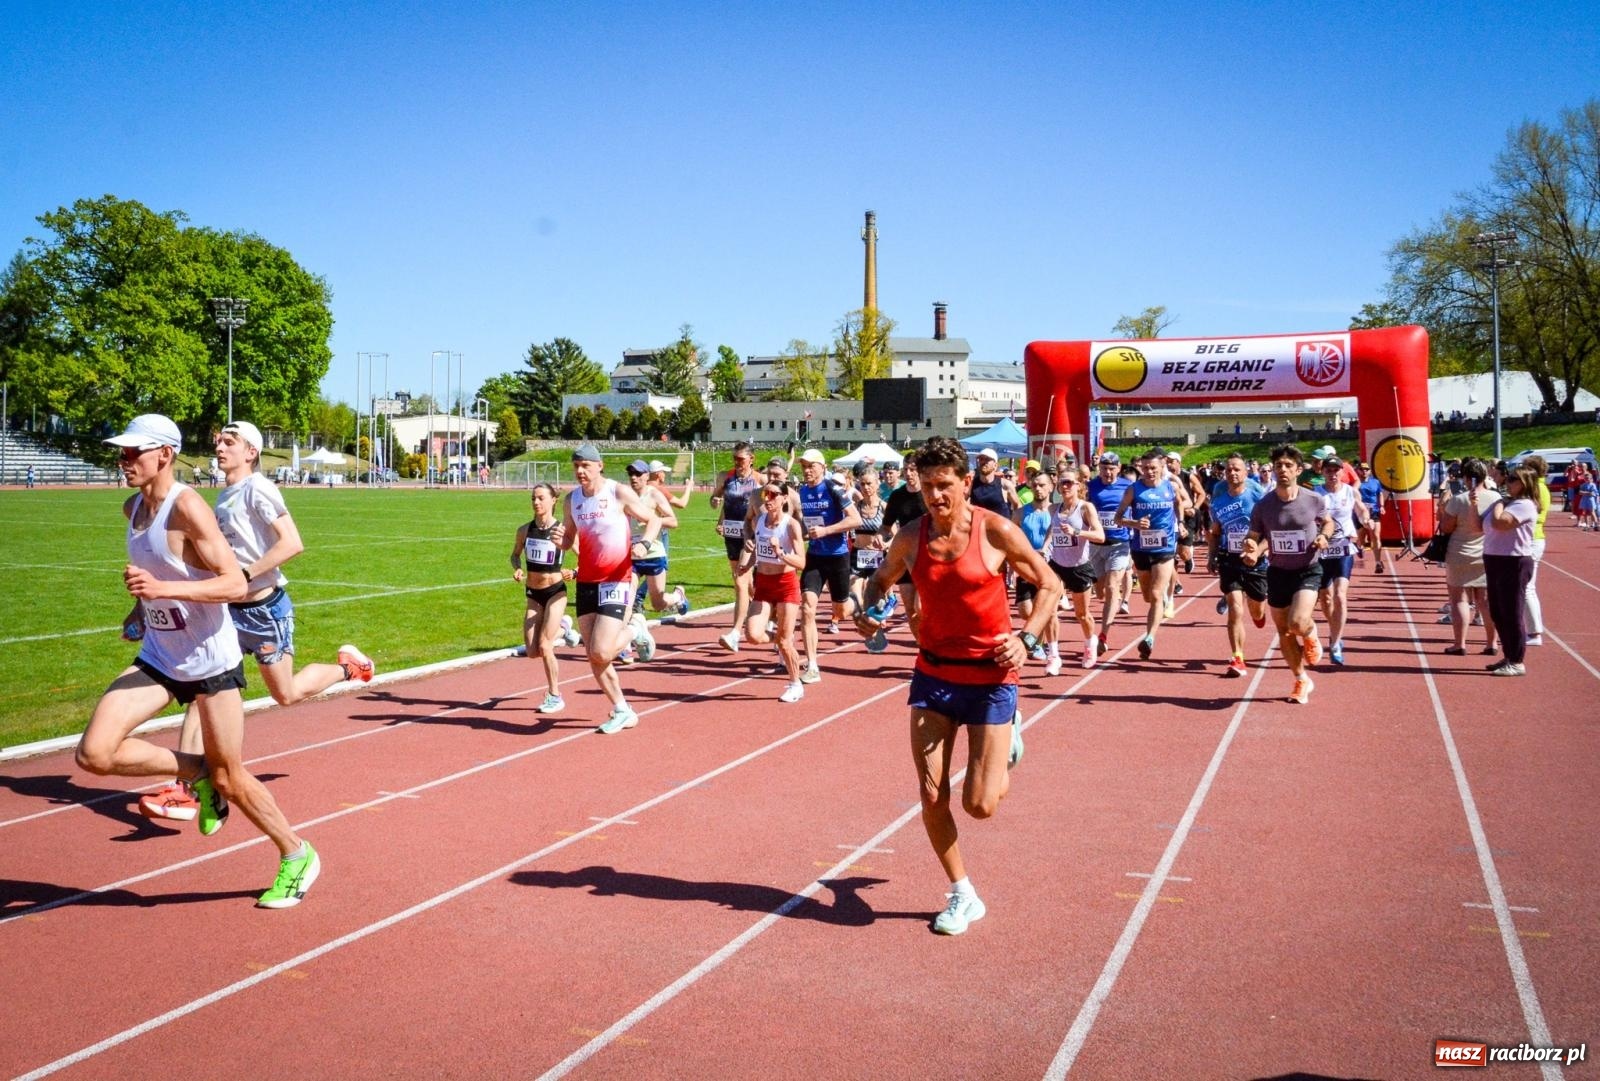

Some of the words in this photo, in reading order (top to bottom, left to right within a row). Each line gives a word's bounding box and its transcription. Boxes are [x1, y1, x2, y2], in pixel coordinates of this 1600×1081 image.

[1195, 343, 1241, 355] BIEG
[1161, 361, 1201, 375] BEZ
[1203, 358, 1276, 374] GRANIC
[1171, 376, 1267, 393] RACIBÓRZ
[1216, 501, 1243, 518] MORSY
[577, 511, 605, 520] POLSKA
[725, 527, 739, 535] 242
[1055, 536, 1069, 545] 182
[1144, 537, 1159, 546] 184
[1278, 540, 1294, 550] 112
[531, 549, 541, 559] 111
[760, 544, 773, 555] 135
[605, 589, 621, 600] 161
[147, 608, 168, 625] 193
